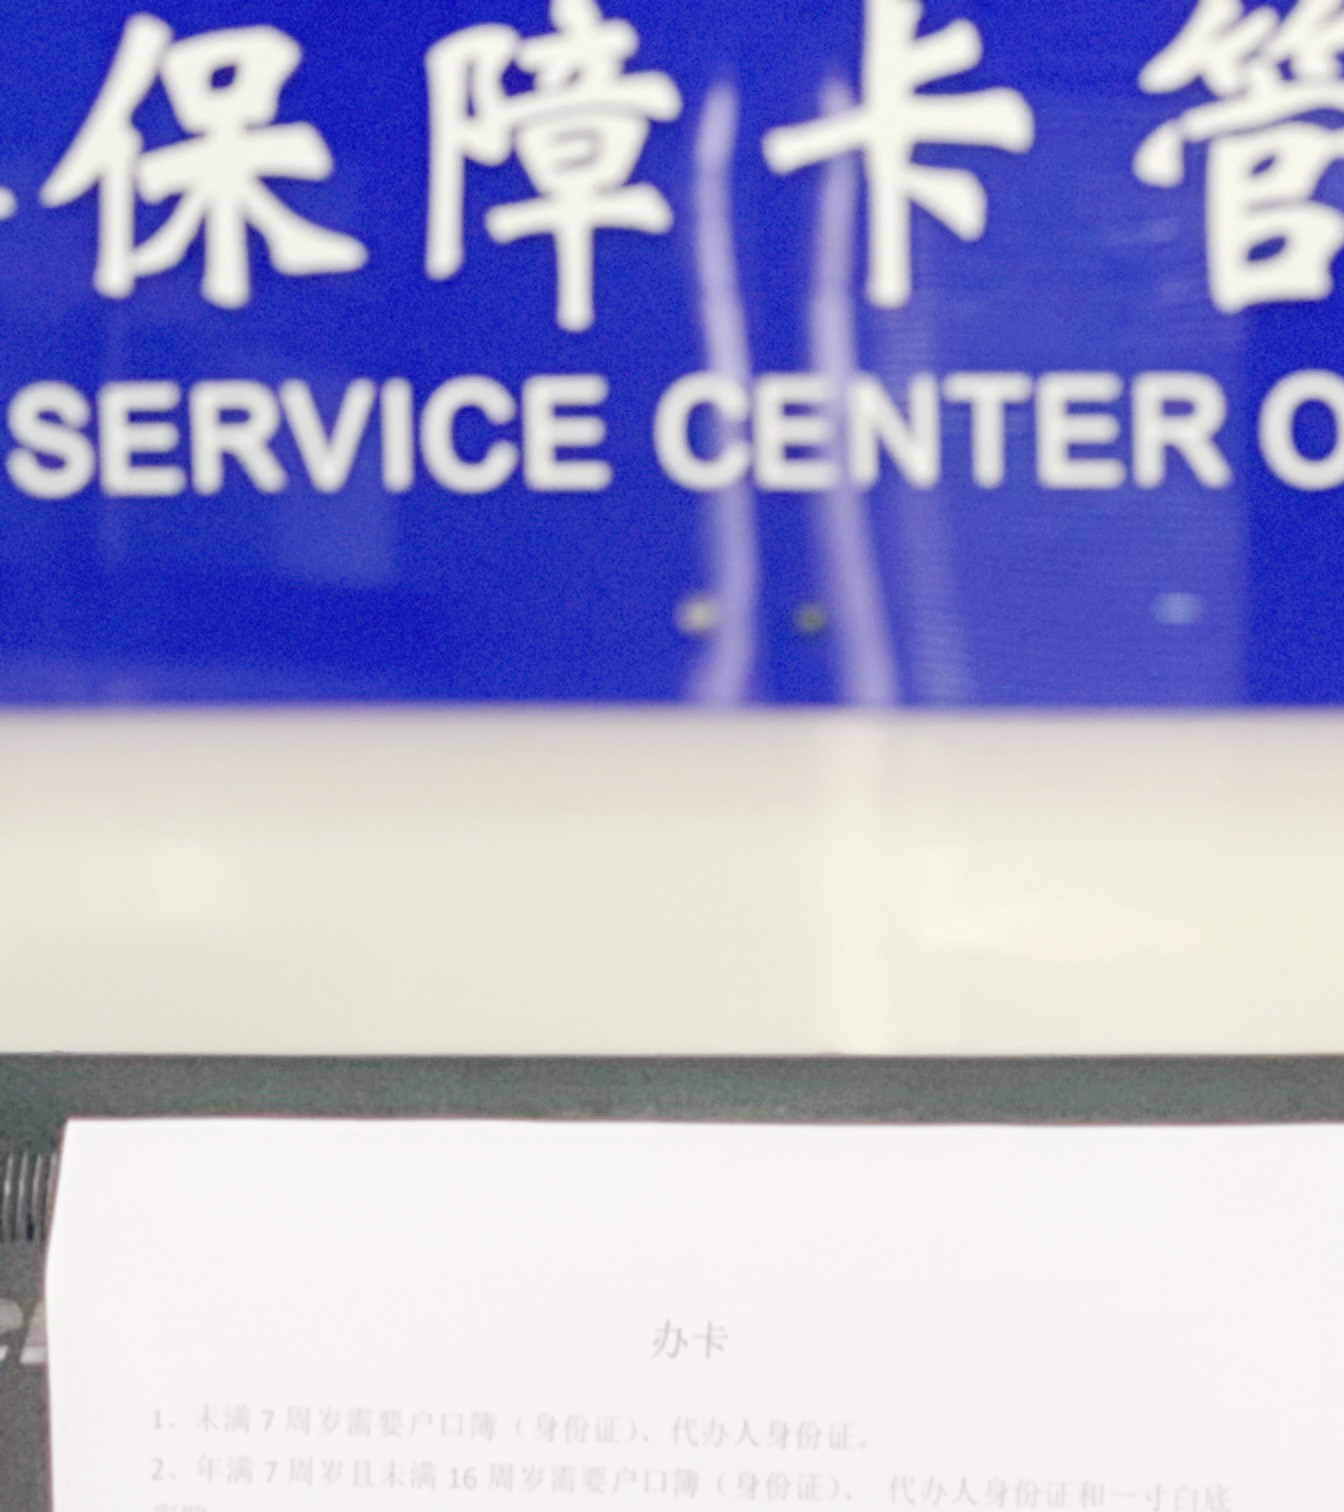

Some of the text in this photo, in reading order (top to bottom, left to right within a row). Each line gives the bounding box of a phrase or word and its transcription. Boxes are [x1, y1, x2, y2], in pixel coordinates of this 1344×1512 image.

[7, 374, 611, 499] SERVICE
[653, 370, 1230, 493] CENTER
[651, 1318, 730, 1361] 办卡
